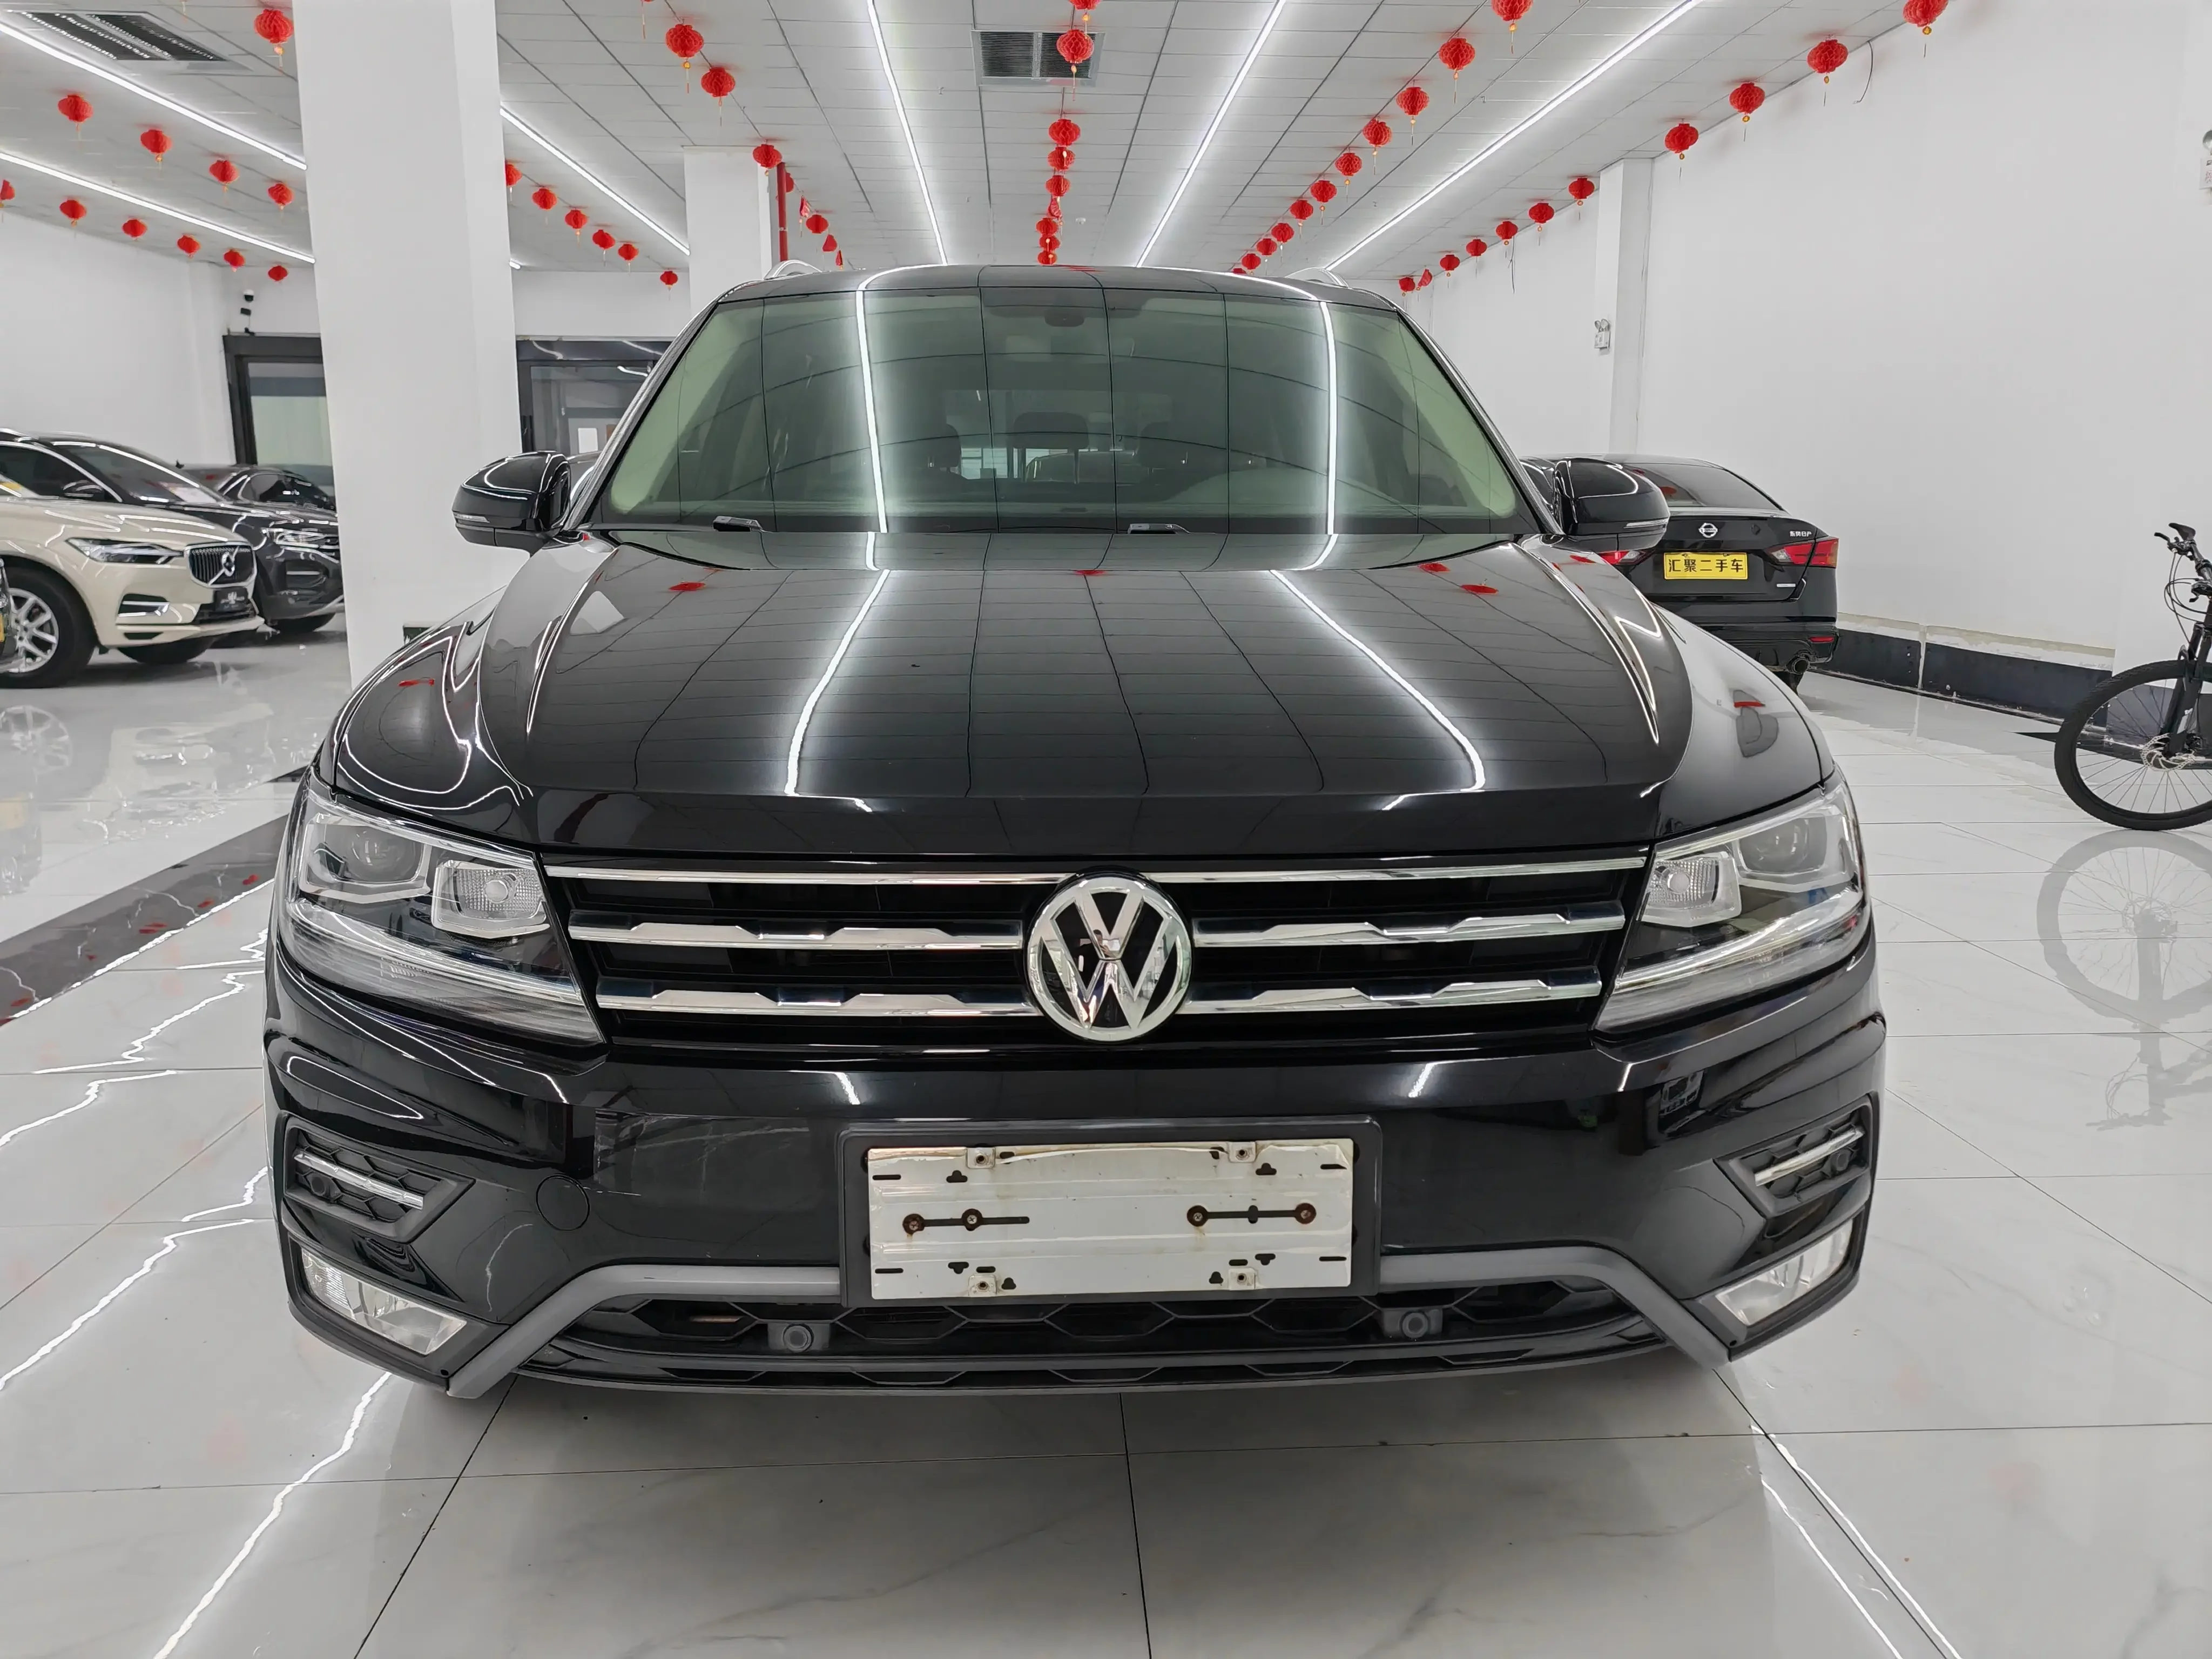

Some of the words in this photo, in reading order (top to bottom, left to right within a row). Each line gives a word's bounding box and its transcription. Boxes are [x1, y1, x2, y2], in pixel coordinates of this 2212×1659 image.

[1668, 558, 1744, 573] 汇聚二手车
